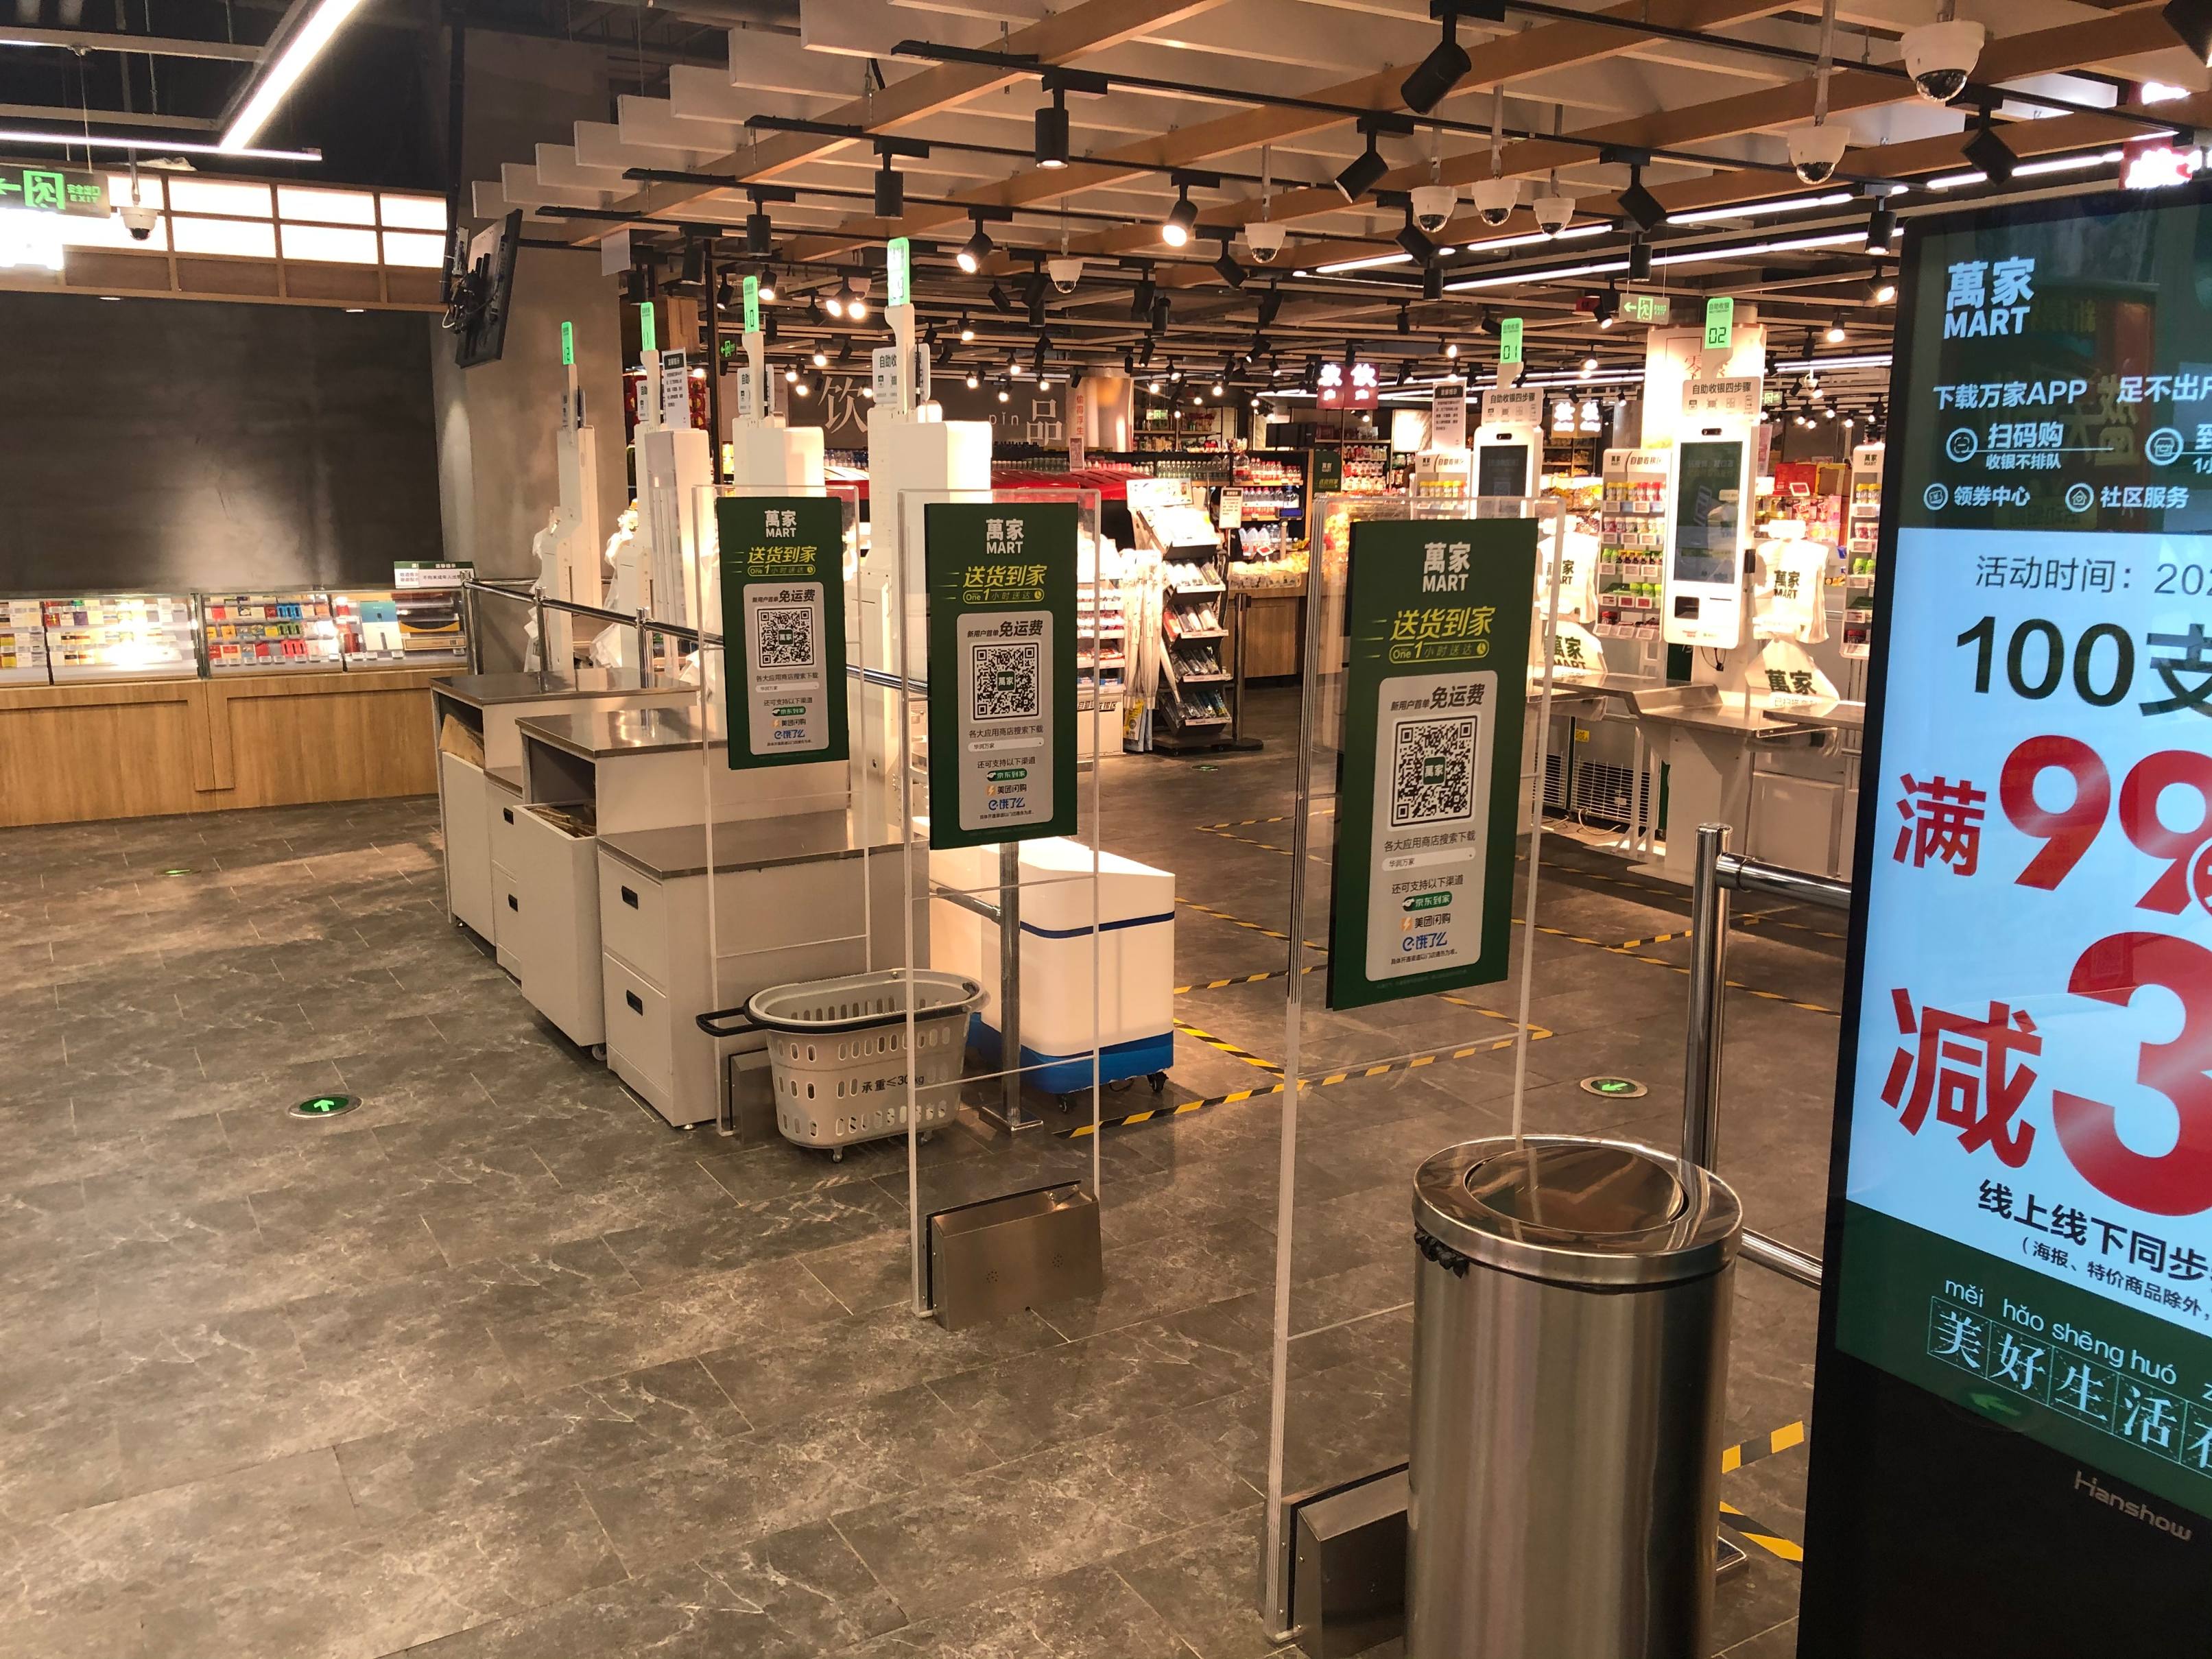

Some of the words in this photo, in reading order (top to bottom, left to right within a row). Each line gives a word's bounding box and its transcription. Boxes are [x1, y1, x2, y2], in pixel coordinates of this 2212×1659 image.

[70, 194, 99, 203] EXIT
[1947, 256, 2036, 309] 萬家
[1943, 305, 2031, 339] MART
[1708, 327, 1727, 344] 02
[879, 354, 897, 368] 自助收
[1503, 345, 1518, 359] 01
[1692, 381, 1752, 394] 自助收银四步骤
[1932, 379, 2088, 410] 下载万家APP
[1490, 392, 1536, 404] 自助收银四步骤
[1027, 398, 1062, 446] 品
[1988, 421, 2064, 449] 扫码购
[1986, 452, 2062, 470] 收银不排队
[1953, 486, 2030, 508] 领券中心
[2100, 486, 2190, 509] 社区服务
[764, 510, 798, 527] 萬家
[765, 527, 796, 538] MART
[986, 518, 1024, 541] 萬家
[747, 546, 818, 564] 送货到家
[986, 541, 1023, 554] MART
[1424, 541, 1471, 575] 萬家
[963, 564, 1047, 588] 送货到家
[1423, 573, 1469, 593] MART
[1774, 570, 1800, 588] 萬家
[966, 593, 982, 601] One
[1773, 588, 1798, 599] MART
[1390, 606, 1496, 641] 送货到家
[1392, 649, 1412, 660] One
[1765, 669, 1817, 695] 萬家
[968, 725, 1044, 739] 各大应用商店搜索下载
[977, 756, 1036, 769] 还可支持以下渠道
[1425, 764, 1444, 777] 萬家
[999, 797, 1026, 810] 饿了么
[1383, 830, 1476, 853] 各大应用商店搜索下载
[1392, 874, 1464, 895] 还可支持以下渠道
[1414, 894, 1451, 907] 京东到家
[1414, 913, 1451, 929] 美团闪购
[1416, 931, 1448, 950] 饿了么
[1978, 1179, 2207, 1282] 线上线下同步
[2052, 1322, 2124, 1368] shēng
[2130, 1349, 2177, 1385] huó
[2073, 1470, 2193, 1542] Hanshow
